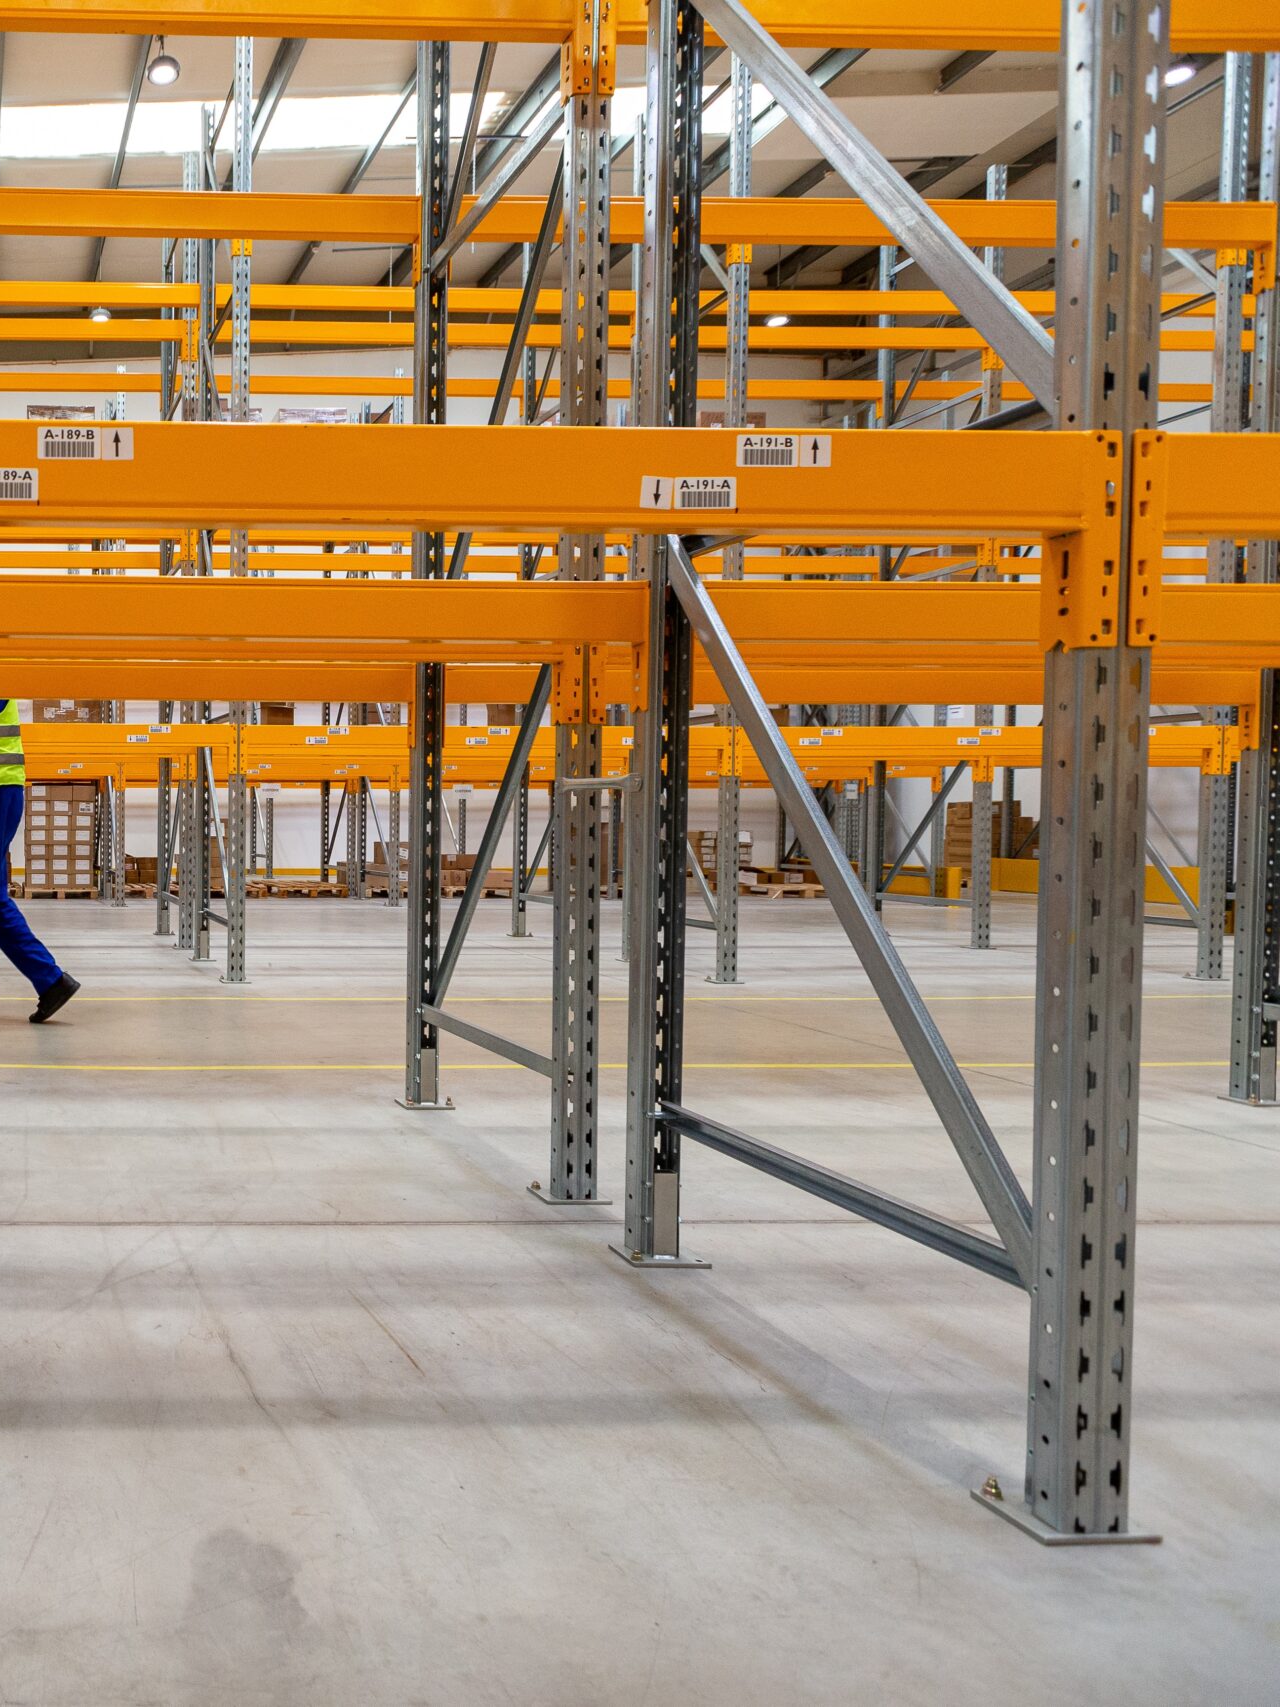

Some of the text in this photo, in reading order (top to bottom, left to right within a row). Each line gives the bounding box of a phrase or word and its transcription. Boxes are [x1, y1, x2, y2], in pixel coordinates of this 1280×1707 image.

[44, 429, 95, 440] A-189-B
[743, 437, 793, 448] A-191-B
[679, 479, 731, 490] A-191-A
